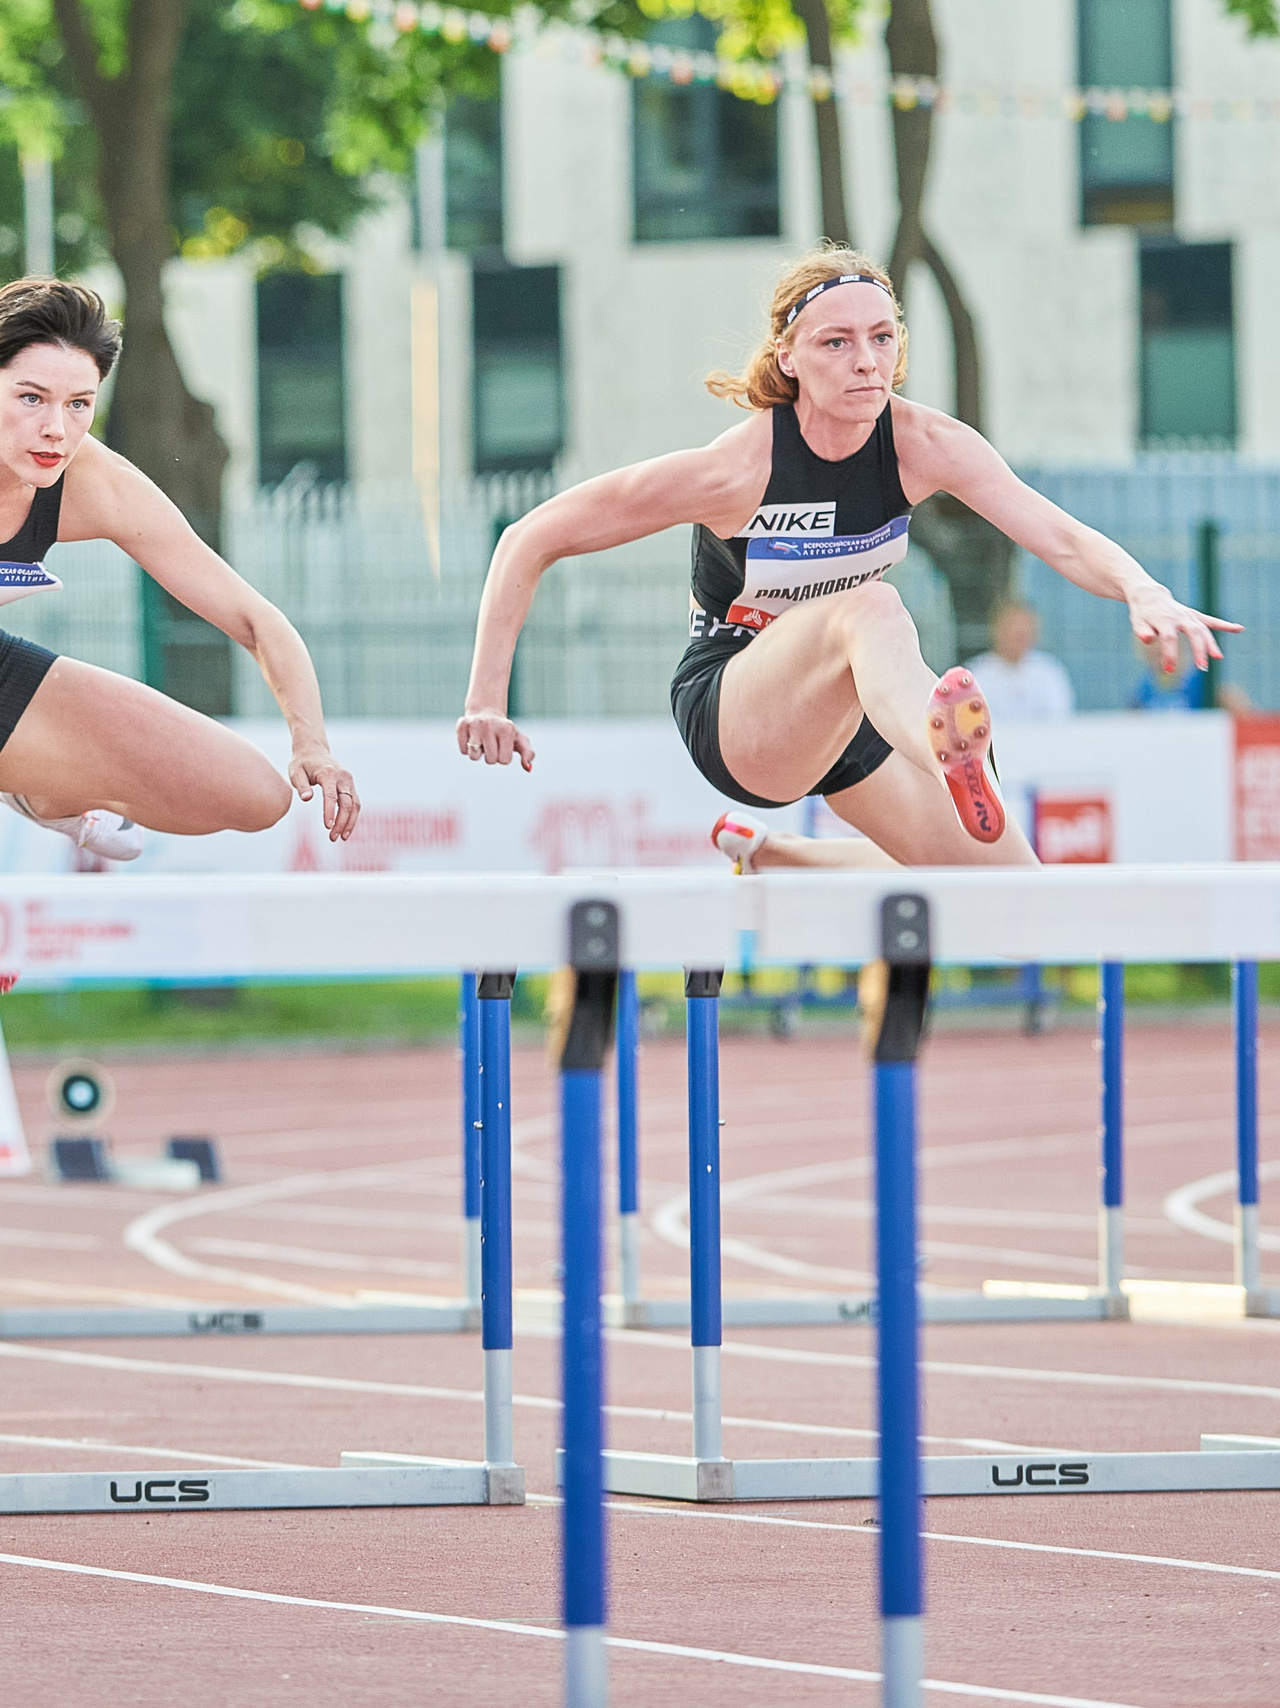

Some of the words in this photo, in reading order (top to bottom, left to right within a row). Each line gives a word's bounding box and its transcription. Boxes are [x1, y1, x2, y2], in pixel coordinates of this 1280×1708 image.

[748, 510, 836, 532] NIKE
[992, 1463, 1090, 1486] UCS
[110, 1480, 210, 1502] UCS
